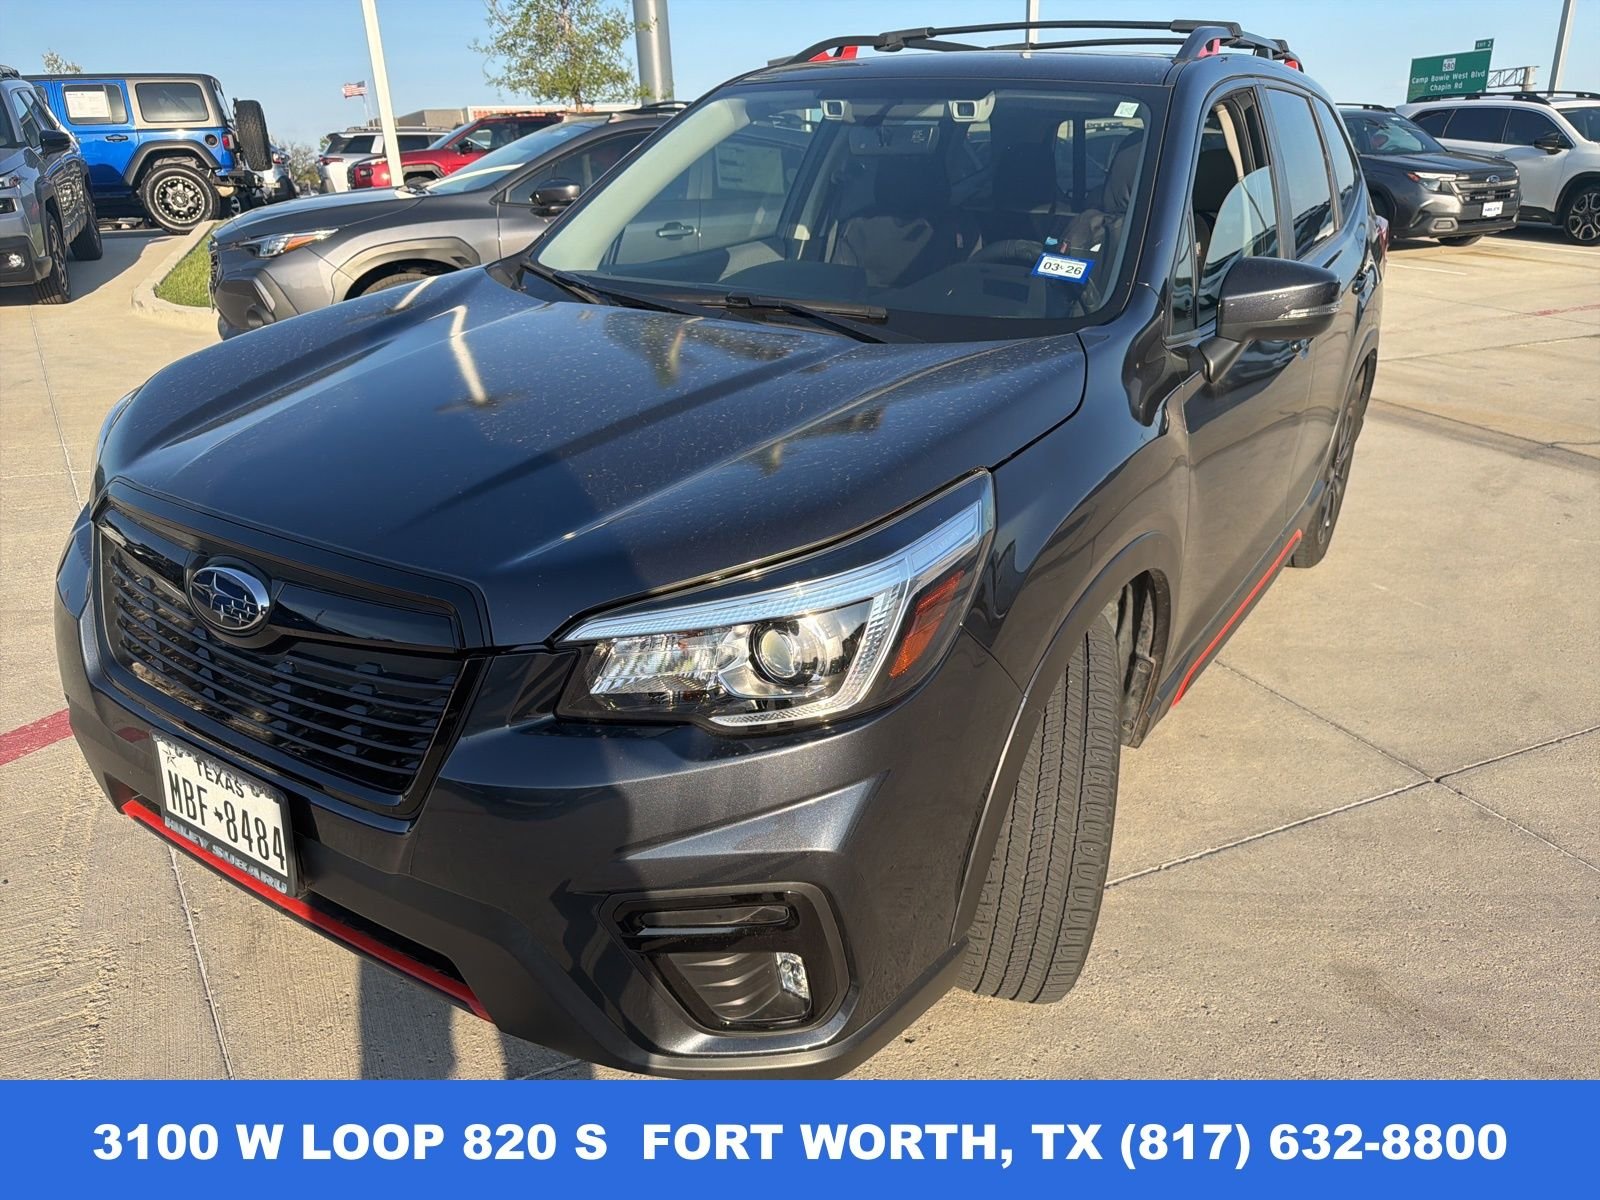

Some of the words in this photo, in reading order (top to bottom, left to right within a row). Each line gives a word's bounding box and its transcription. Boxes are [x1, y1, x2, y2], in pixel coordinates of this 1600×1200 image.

[1443, 62, 1455, 70] 580
[1412, 76, 1428, 84] Camp
[1431, 73, 1450, 82] Bowie
[1452, 71, 1468, 79] West
[1471, 70, 1486, 79] Blvd
[1430, 83, 1452, 92] Chapin
[195, 760, 245, 798] TEXAS
[212, 844, 288, 894] SUBARU
